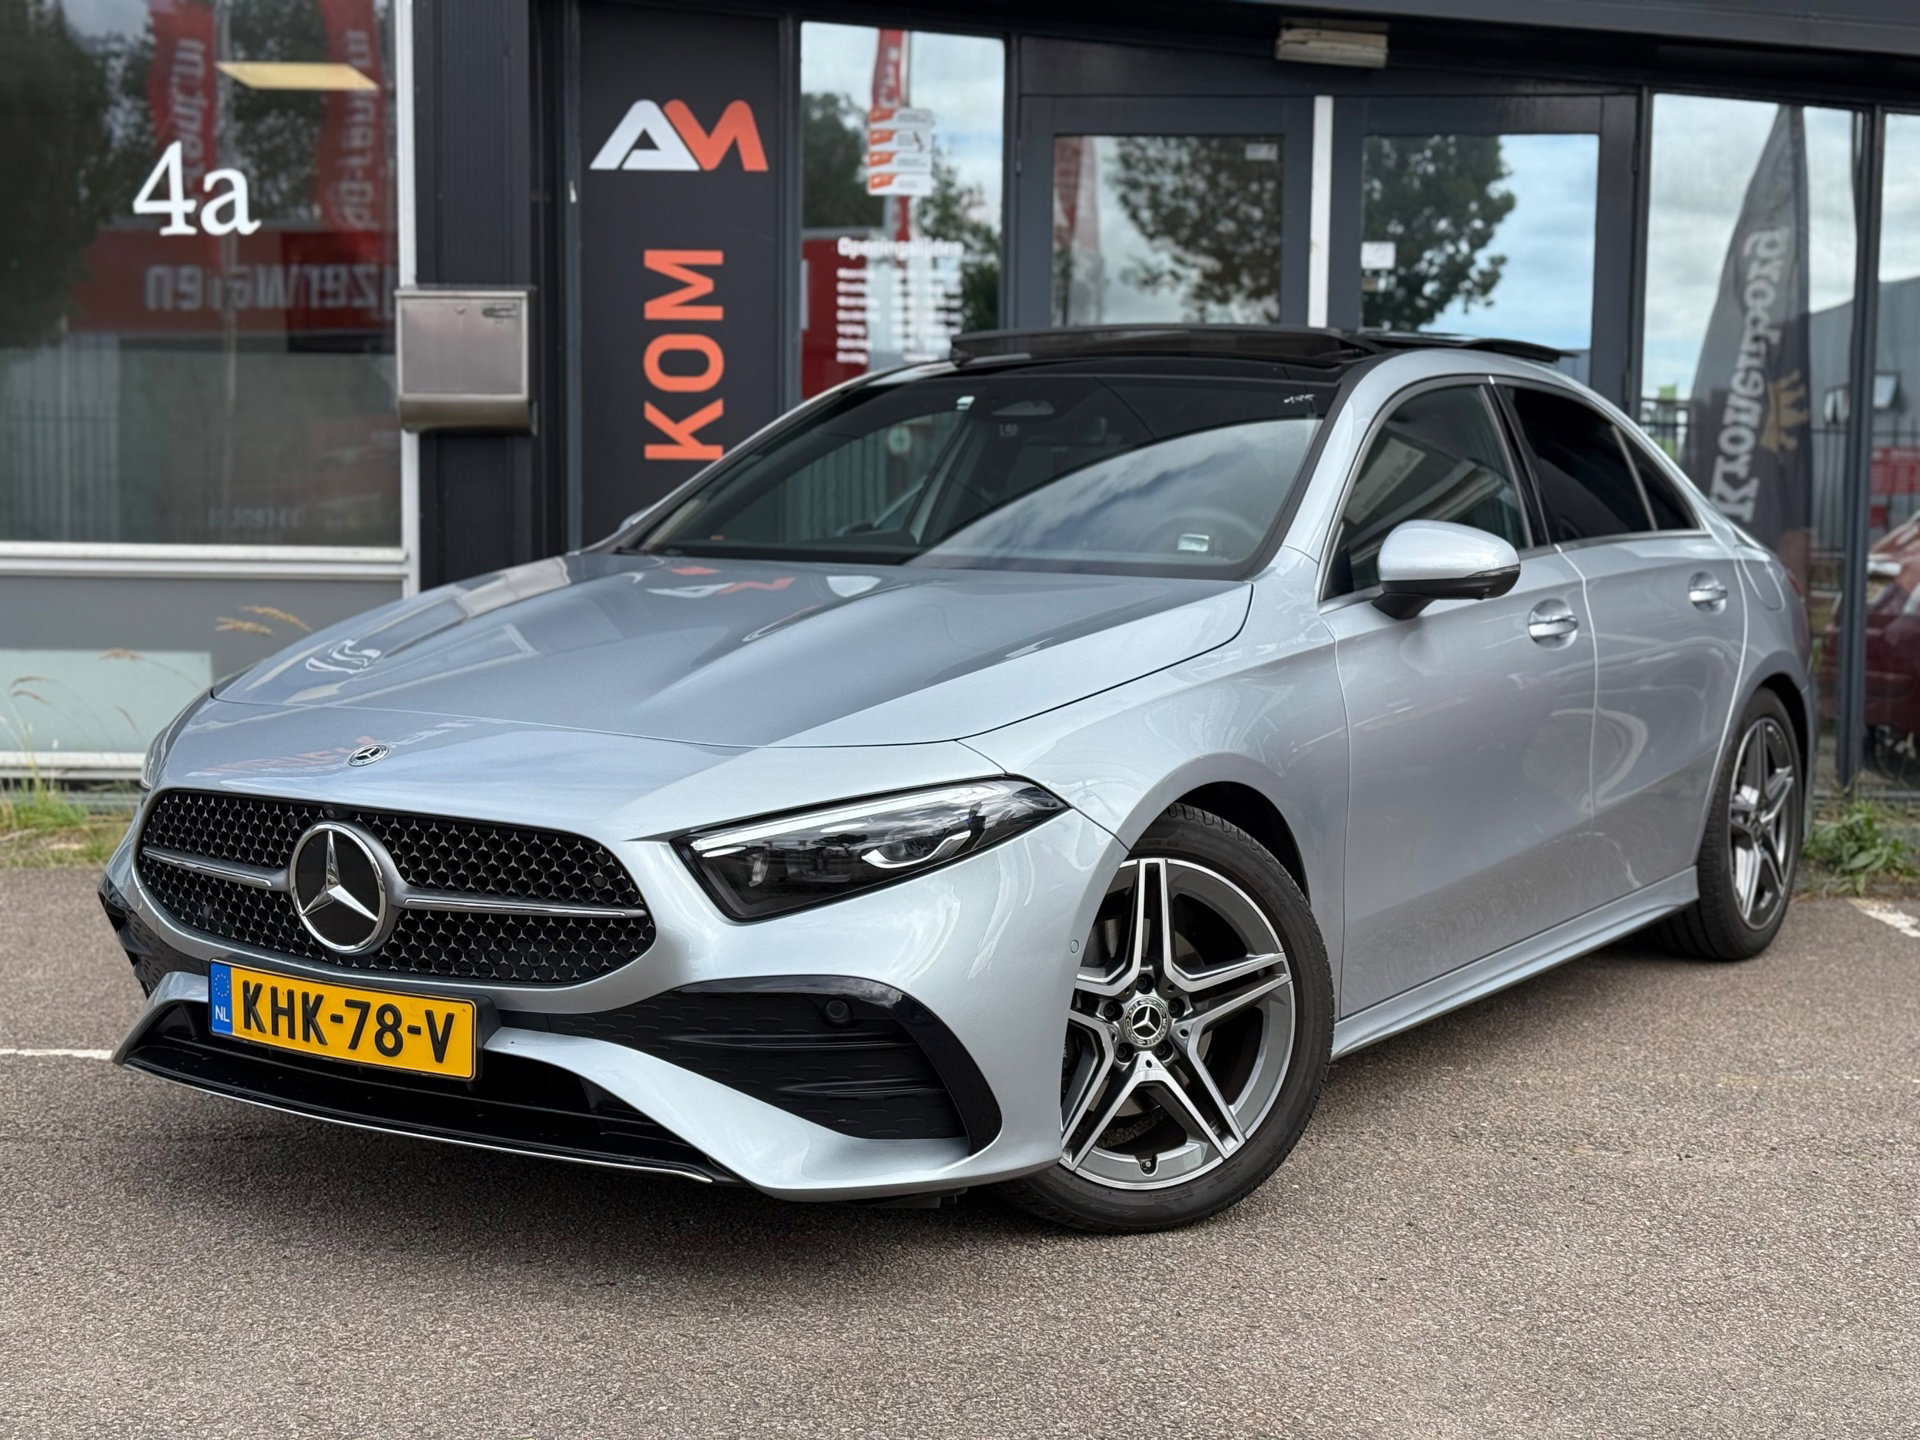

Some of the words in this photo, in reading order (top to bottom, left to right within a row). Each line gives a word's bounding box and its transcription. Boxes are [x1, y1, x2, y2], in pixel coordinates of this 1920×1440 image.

[589, 99, 769, 171] AM
[133, 141, 261, 236] 4a
[214, 1004, 231, 1023] NL
[242, 980, 455, 1063] KHK-78-V
